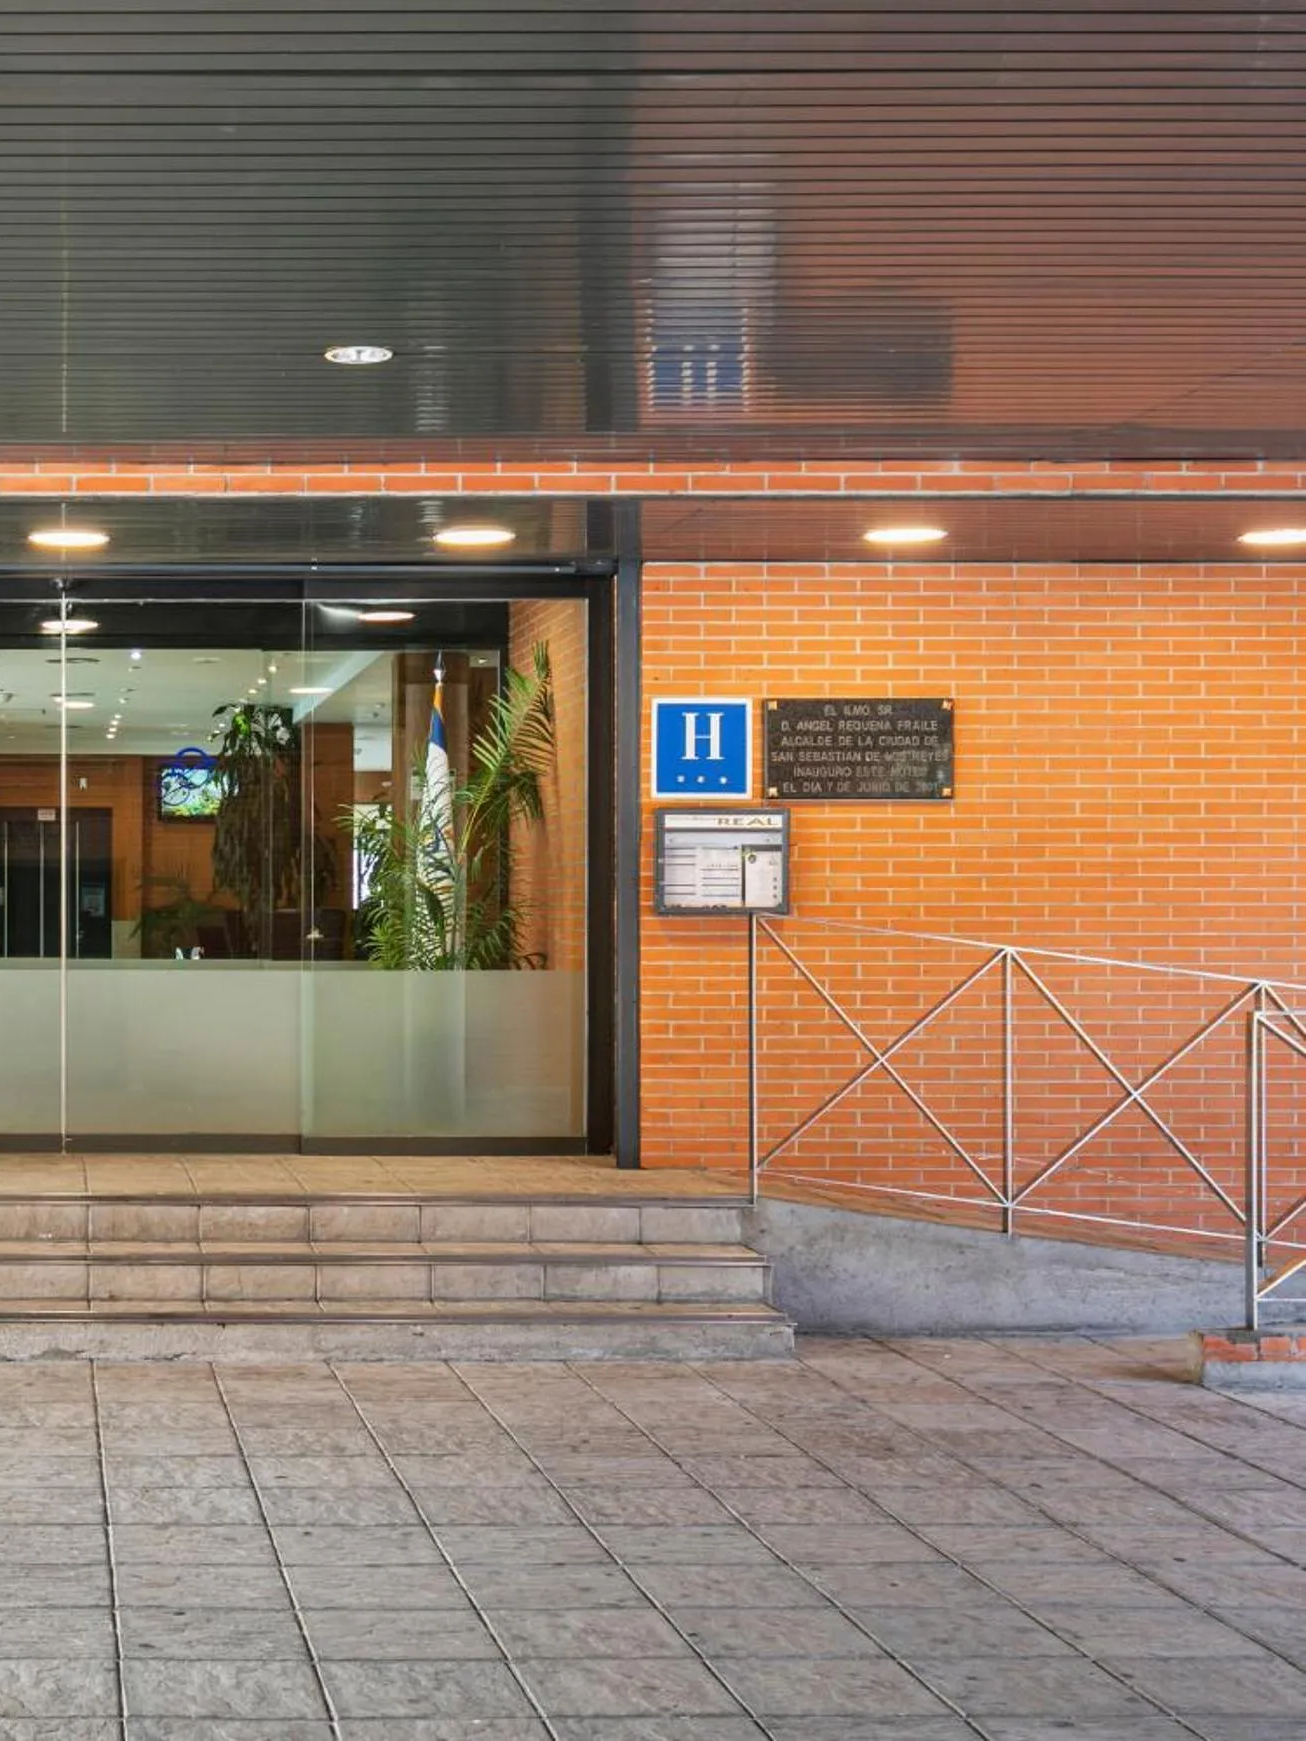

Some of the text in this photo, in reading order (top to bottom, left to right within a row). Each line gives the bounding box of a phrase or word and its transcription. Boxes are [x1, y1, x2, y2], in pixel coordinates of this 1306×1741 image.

[797, 720, 833, 732] ANGEL
[897, 720, 938, 732] FRAILE
[682, 712, 725, 760] H
[781, 735, 833, 747] ALCALDE
[838, 735, 853, 747] DE
[924, 735, 939, 747] DE
[771, 751, 793, 762] SAN
[865, 751, 880, 762] DE
[783, 782, 797, 793] EL
[717, 818, 779, 826] REAL
